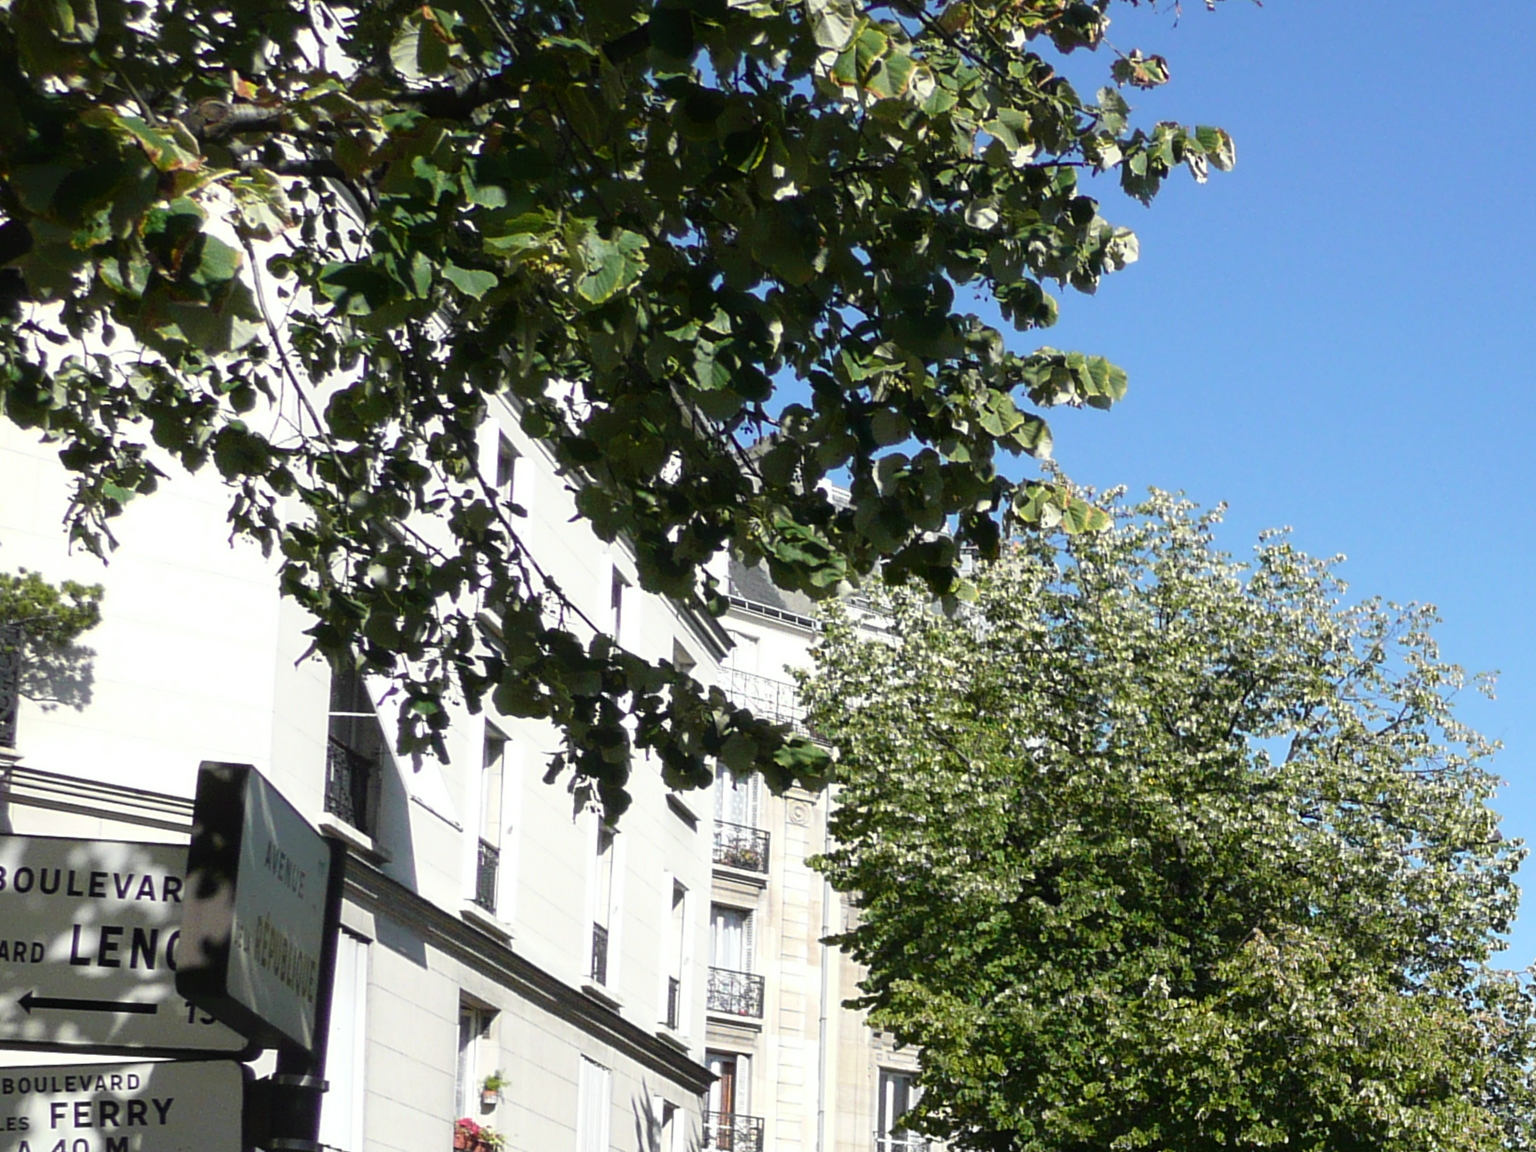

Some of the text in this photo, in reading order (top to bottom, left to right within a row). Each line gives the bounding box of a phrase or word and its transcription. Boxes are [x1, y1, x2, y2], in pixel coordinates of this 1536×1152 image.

[264, 840, 306, 899] AVENUE
[254, 912, 317, 1003] RÉPUBLIQUE
[2, 1074, 140, 1095] BOULEVARD
[50, 1098, 174, 1129] FERRY
